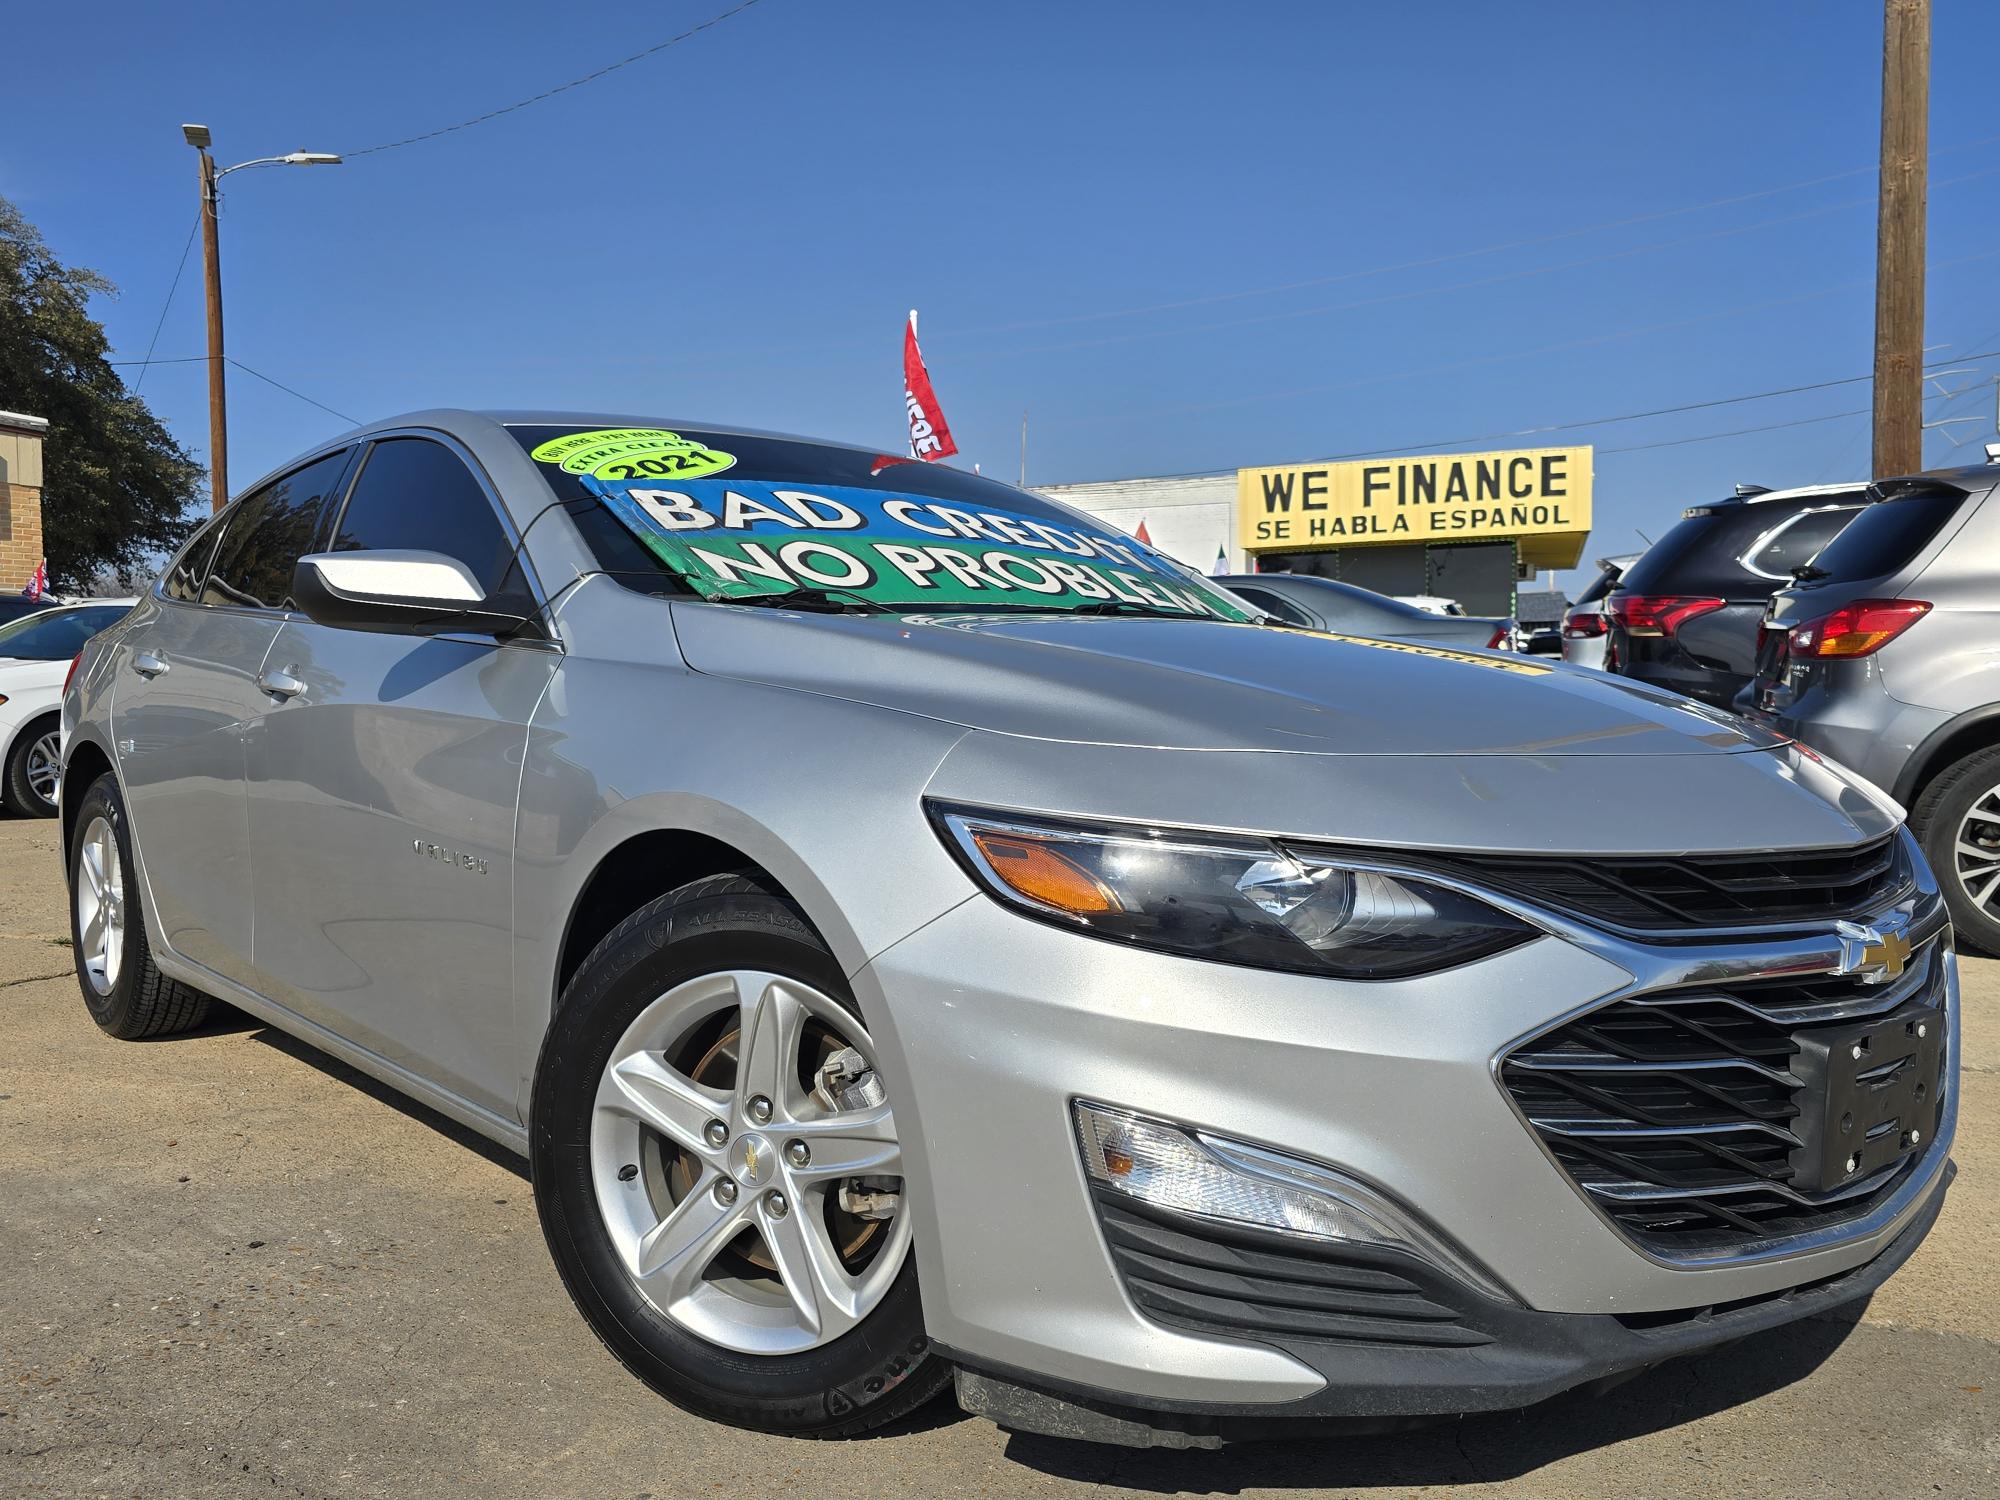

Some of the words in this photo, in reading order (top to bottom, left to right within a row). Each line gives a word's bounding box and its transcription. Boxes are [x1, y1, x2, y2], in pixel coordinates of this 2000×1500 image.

[571, 447, 623, 471] EXTRA
[626, 442, 692, 450] CLEAN
[609, 450, 719, 480] 2021
[1260, 471, 1328, 513] WE
[1362, 455, 1567, 508] FINANCE
[626, 488, 868, 531] BAD
[880, 500, 1156, 574] CREDIT
[1256, 519, 1291, 541] SE
[1310, 513, 1411, 538] HABLA
[1430, 503, 1570, 531] ESPAÑOL
[688, 540, 878, 589] NO
[871, 543, 1234, 622] PROBLEM
